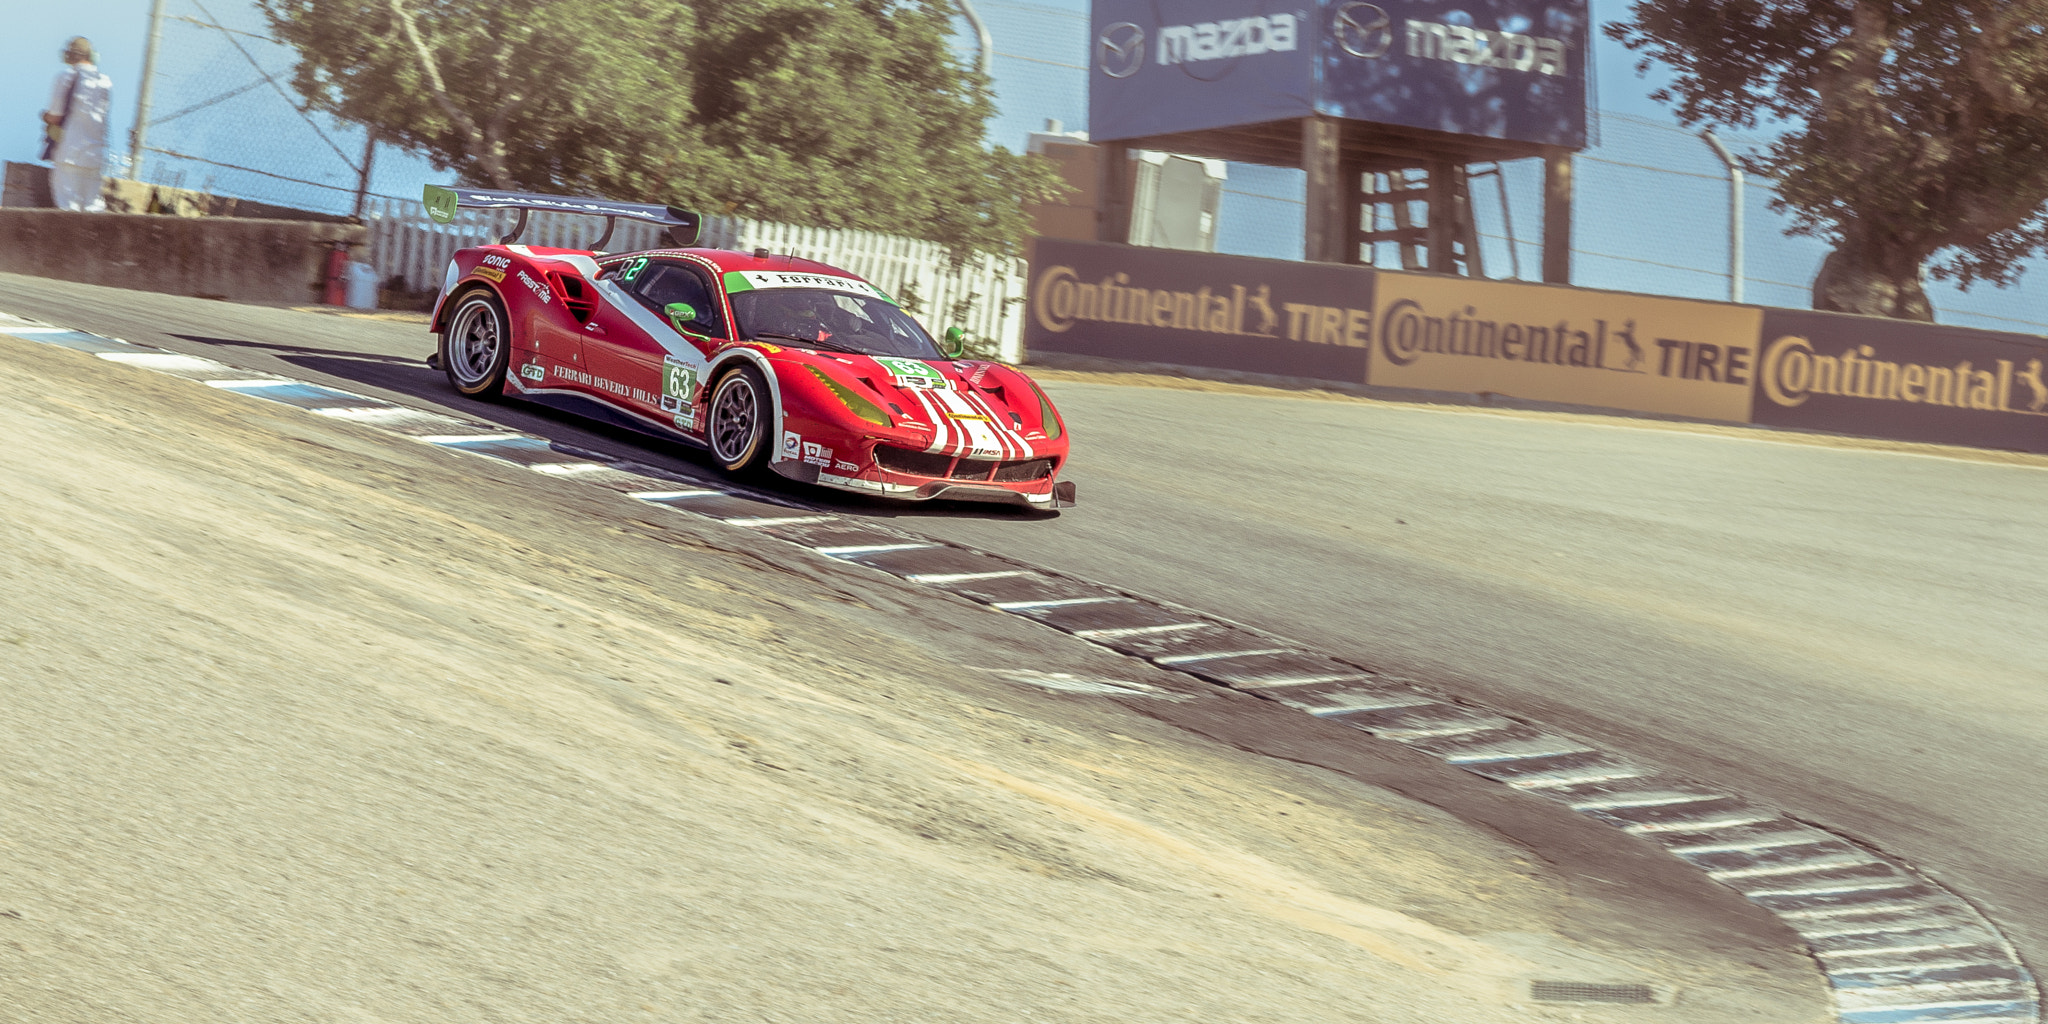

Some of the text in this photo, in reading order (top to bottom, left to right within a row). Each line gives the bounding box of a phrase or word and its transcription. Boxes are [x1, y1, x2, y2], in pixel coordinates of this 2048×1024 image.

[1156, 12, 1298, 66] mazda
[1405, 18, 1568, 77] mazda
[776, 274, 854, 289] Ferrari
[1034, 265, 1371, 349] Continental TIRE
[1380, 298, 1752, 386] Continental TIRE
[522, 366, 543, 379] GTD
[553, 364, 592, 386] FERRARI
[593, 375, 631, 398] BEVERLY
[632, 388, 658, 405] HILLS
[669, 366, 690, 400] 63
[892, 360, 929, 376] 63
[1759, 335, 2015, 412] Continental
[834, 463, 860, 473] AERO
